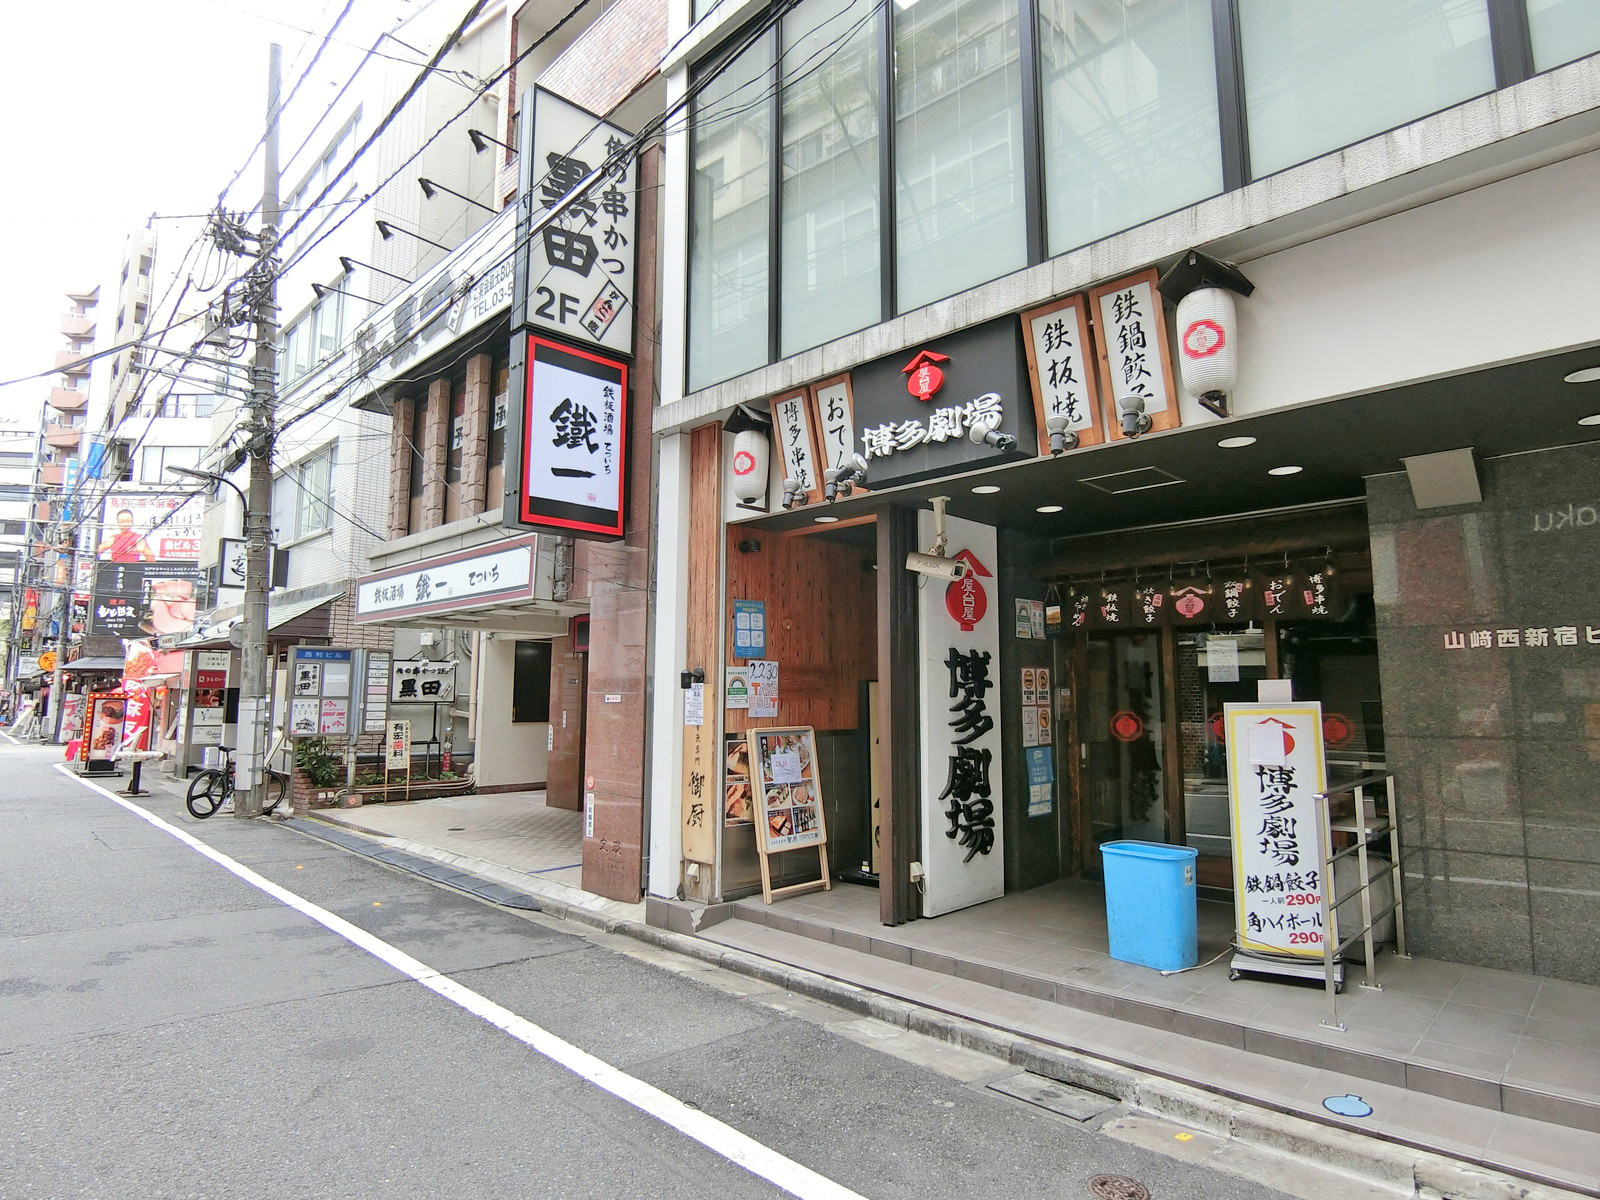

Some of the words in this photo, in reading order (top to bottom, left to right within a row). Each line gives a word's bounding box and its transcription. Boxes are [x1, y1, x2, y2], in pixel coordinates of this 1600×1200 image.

[540, 151, 600, 279] 黒田
[534, 285, 580, 325] 2F
[917, 366, 931, 394] 屋台屋
[1041, 318, 1083, 423] 鉄板焼
[603, 385, 615, 436] 鉄板酒場
[860, 392, 1004, 461] 博多劇場
[603, 441, 613, 475] てついち
[783, 400, 811, 491] 博多串焼
[374, 582, 405, 604] 鉄板酒場
[468, 564, 500, 587] てついち
[960, 578, 977, 621] 屋台屋
[1269, 580, 1287, 614] おでん
[1105, 592, 1119, 622] 鉄板焼
[299, 670, 311, 690] 黒田
[399, 678, 442, 698] 黒田
[751, 682, 778, 696] TAKE
[757, 697, 777, 709] OUT
[938, 647, 996, 864] 博多劇場
[1255, 764, 1300, 867] 博多劇場
[1244, 870, 1321, 894] 鉄鍋餃子
[1261, 896, 1285, 905] 一人前
[1247, 911, 1323, 933] 角ハイボール
